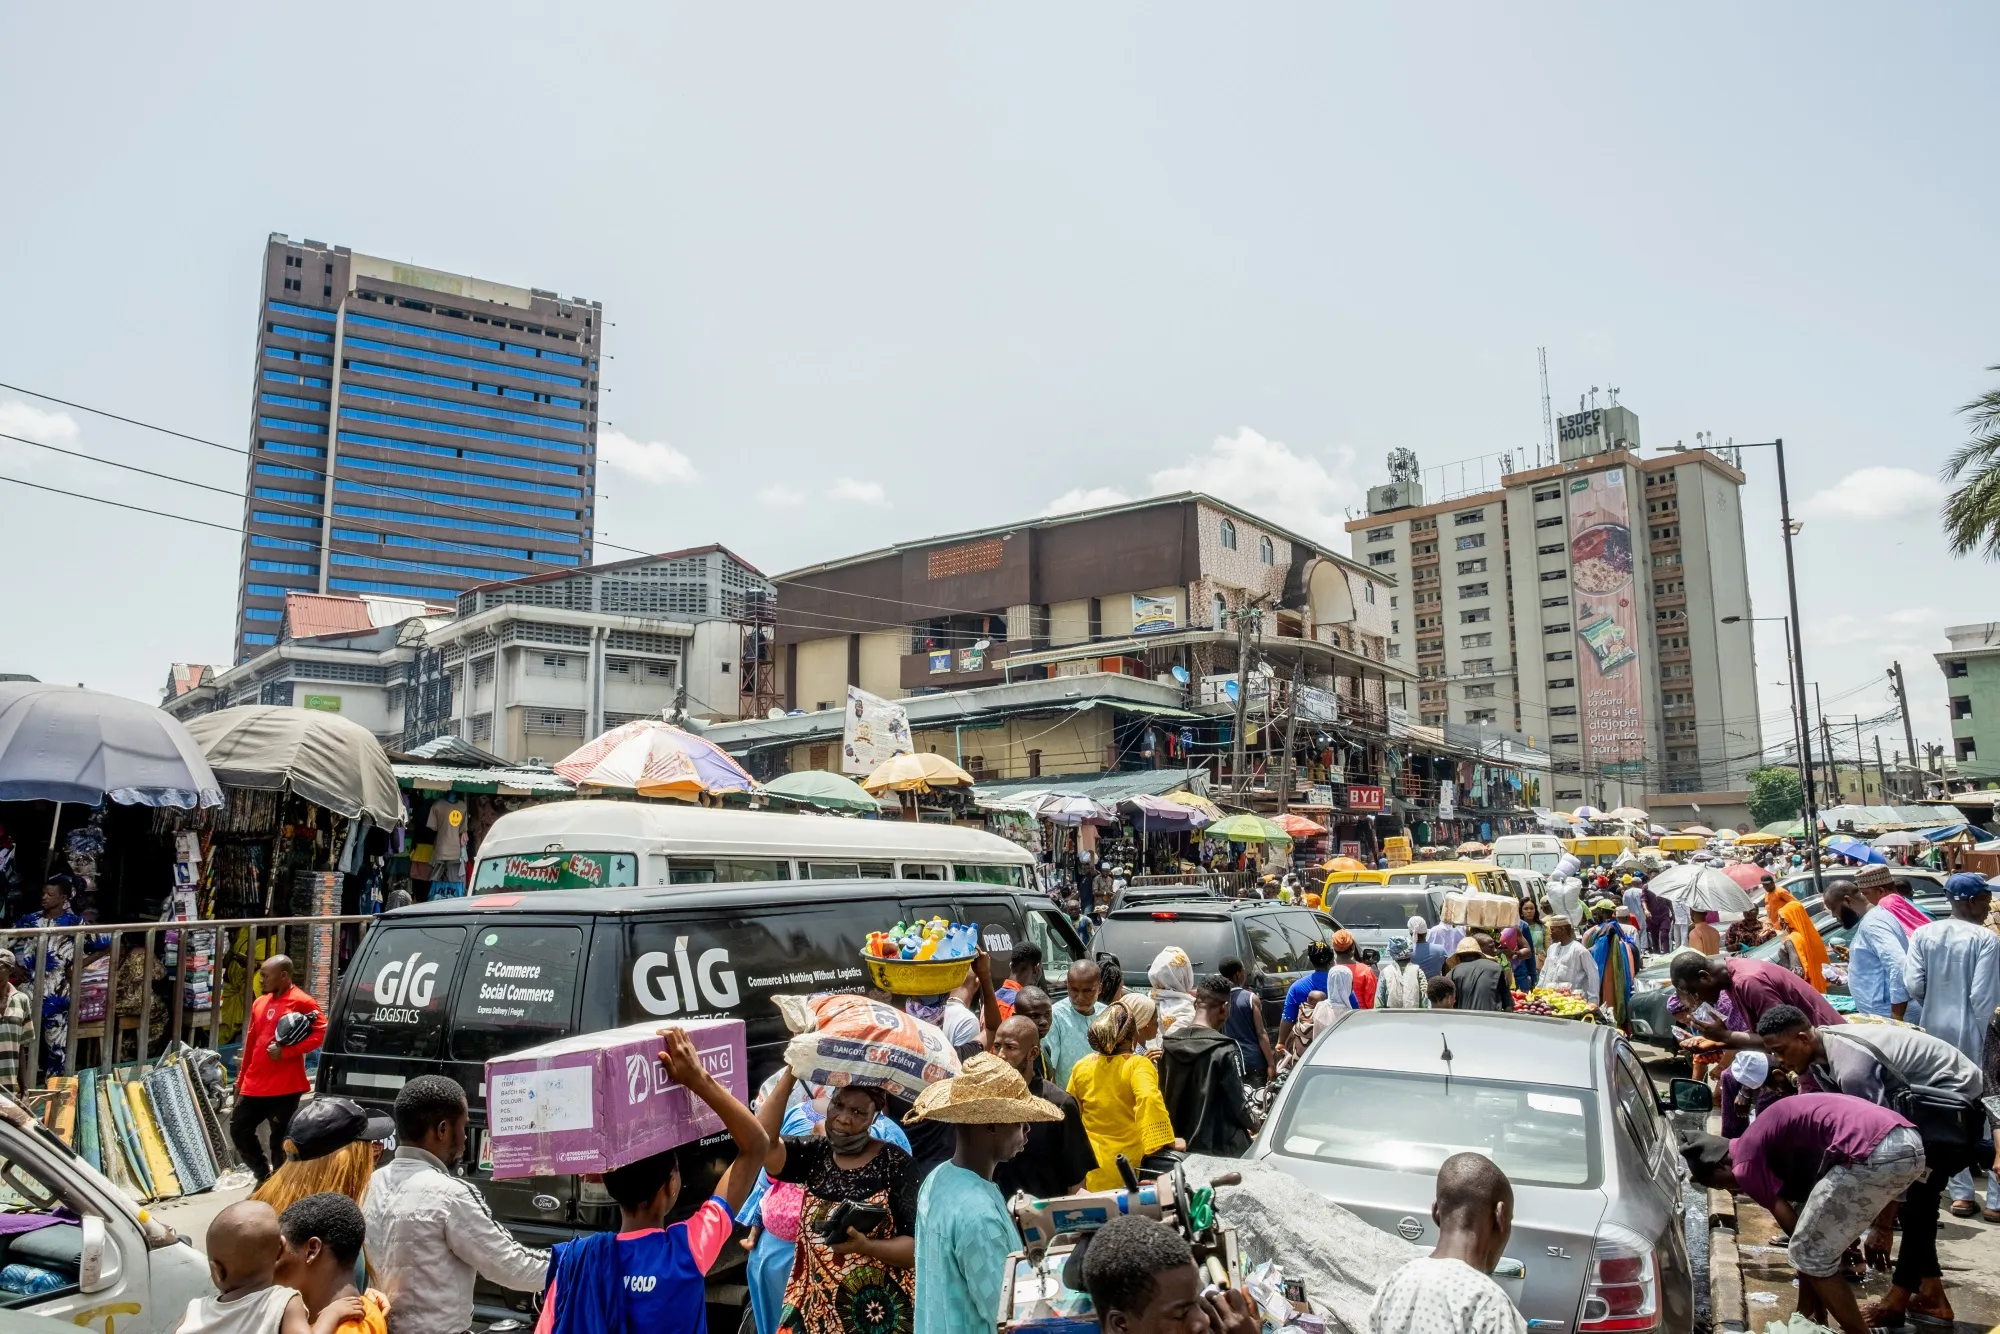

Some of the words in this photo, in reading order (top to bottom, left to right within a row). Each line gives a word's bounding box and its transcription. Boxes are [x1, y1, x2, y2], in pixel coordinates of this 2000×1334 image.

[1559, 409, 1600, 429] LSDPC
[1560, 421, 1601, 442] HOUSE
[1350, 790, 1379, 803] BYC
[569, 854, 602, 882] EDA
[374, 952, 439, 1007] GIG
[485, 961, 541, 979] E-Commerce
[632, 936, 741, 1016] GIG
[747, 976, 783, 987] Commerce
[782, 973, 790, 984] Is
[790, 972, 814, 984] Nothing
[813, 969, 836, 981] Without
[837, 967, 862, 980] Logistics
[479, 983, 507, 1001] Social
[506, 985, 554, 1003] Commerce
[374, 1007, 421, 1024] LOGISTICS
[492, 1006, 508, 1016] Delivery
[510, 1007, 524, 1017] Freight
[832, 1045, 865, 1056] DANGOTE
[868, 1048, 890, 1063] 3X
[889, 1054, 917, 1069] CEMENT
[659, 1052, 728, 1084] DING
[700, 1135, 721, 1146] Express
[720, 1133, 733, 1142] Deli
[538, 1198, 553, 1208] Ford
[1547, 1246, 1571, 1259] SL
[631, 1275, 657, 1292] GOLD
